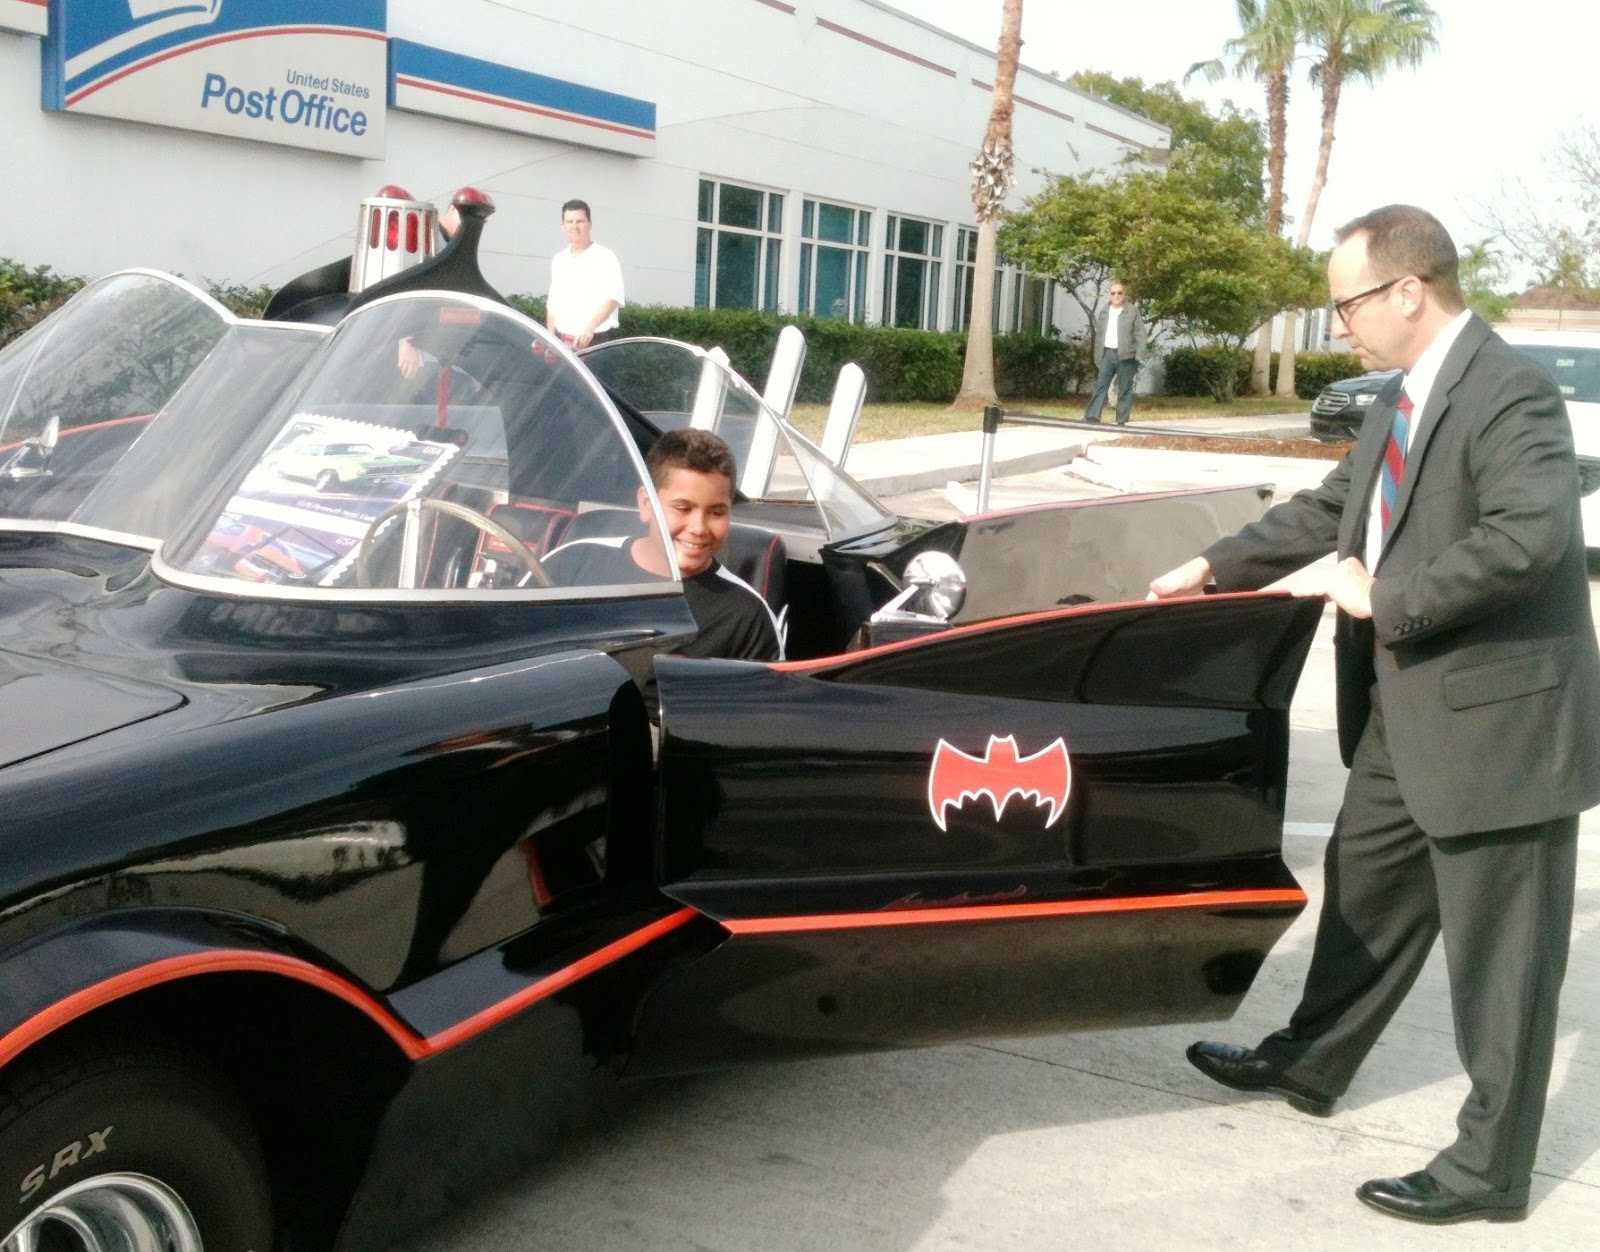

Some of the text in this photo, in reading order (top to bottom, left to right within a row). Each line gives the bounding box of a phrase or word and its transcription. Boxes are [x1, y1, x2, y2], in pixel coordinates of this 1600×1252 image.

[201, 72, 368, 136] Post Office
[286, 69, 370, 99] United States
[19, 1125, 114, 1204] SRX
